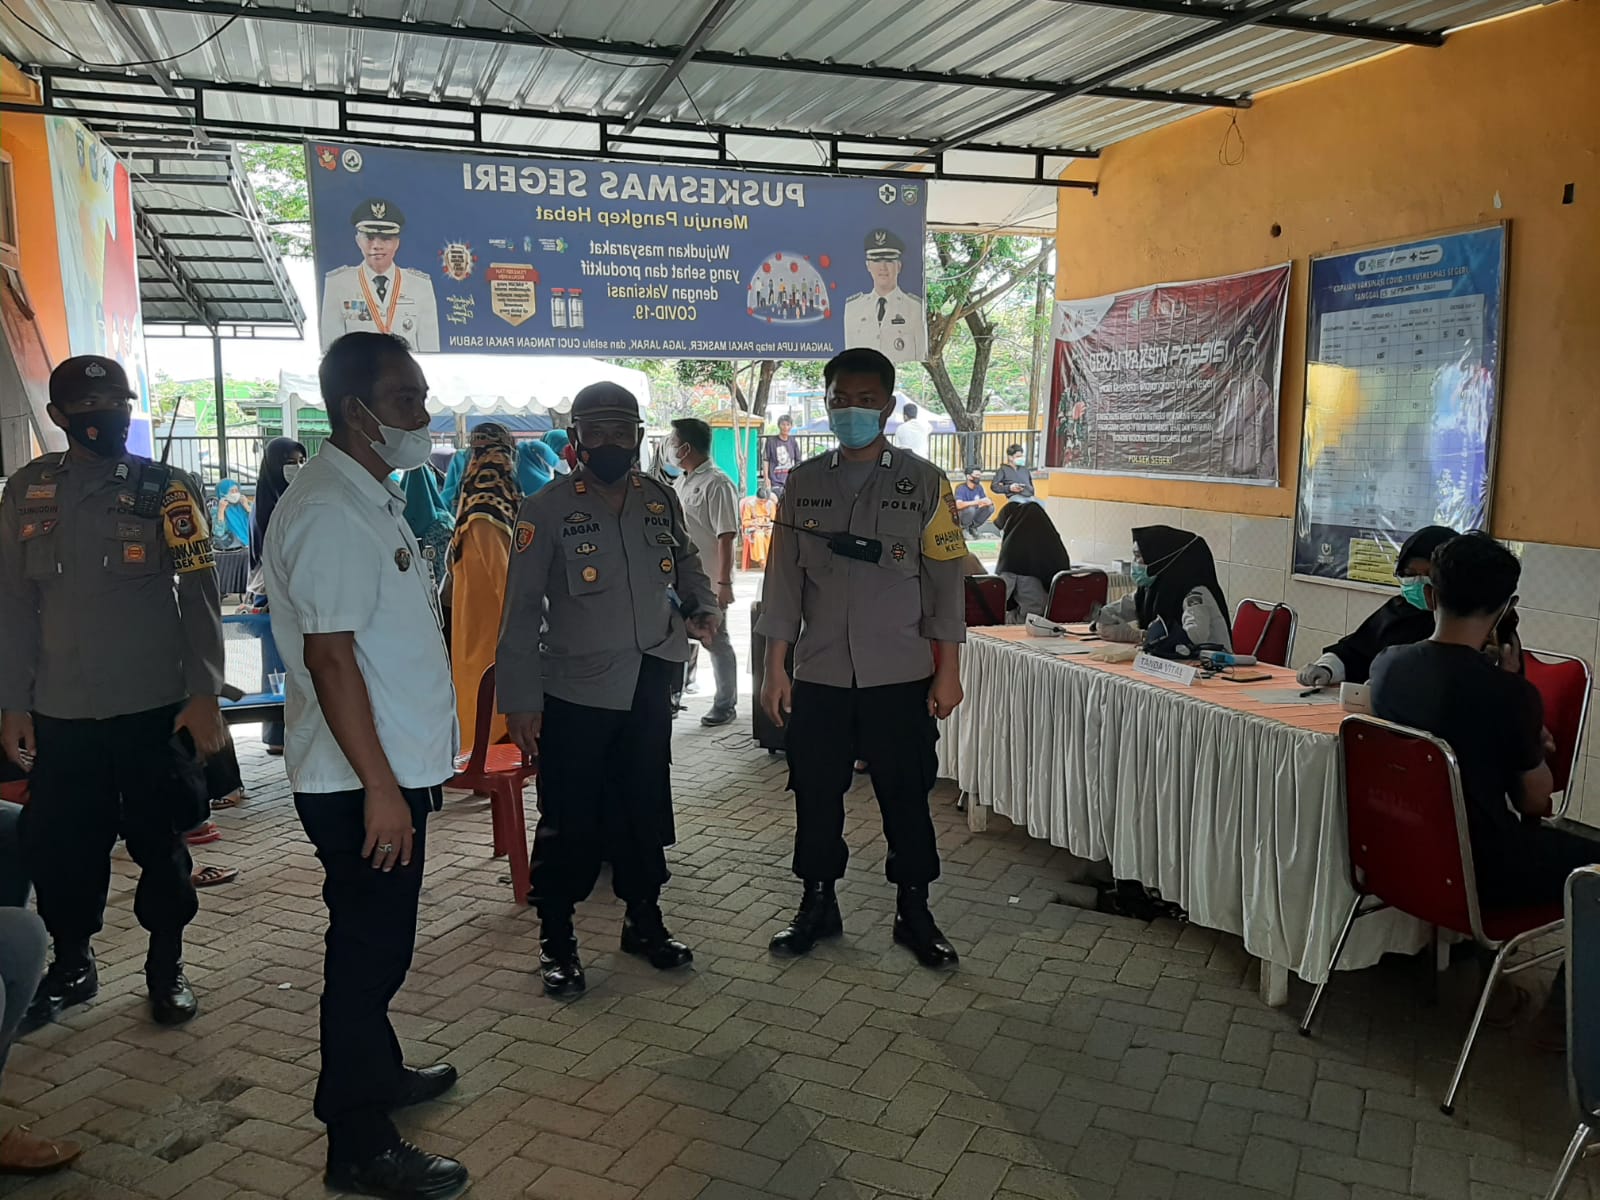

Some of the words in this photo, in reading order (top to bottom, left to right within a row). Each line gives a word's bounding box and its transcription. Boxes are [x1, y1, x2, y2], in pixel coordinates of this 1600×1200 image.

[1121, 345, 1169, 370] VAKSIN
[796, 498, 832, 508] EDWIN
[881, 500, 922, 512] POLRI
[644, 516, 670, 528] POLRI
[1141, 657, 1163, 671] TANDA
